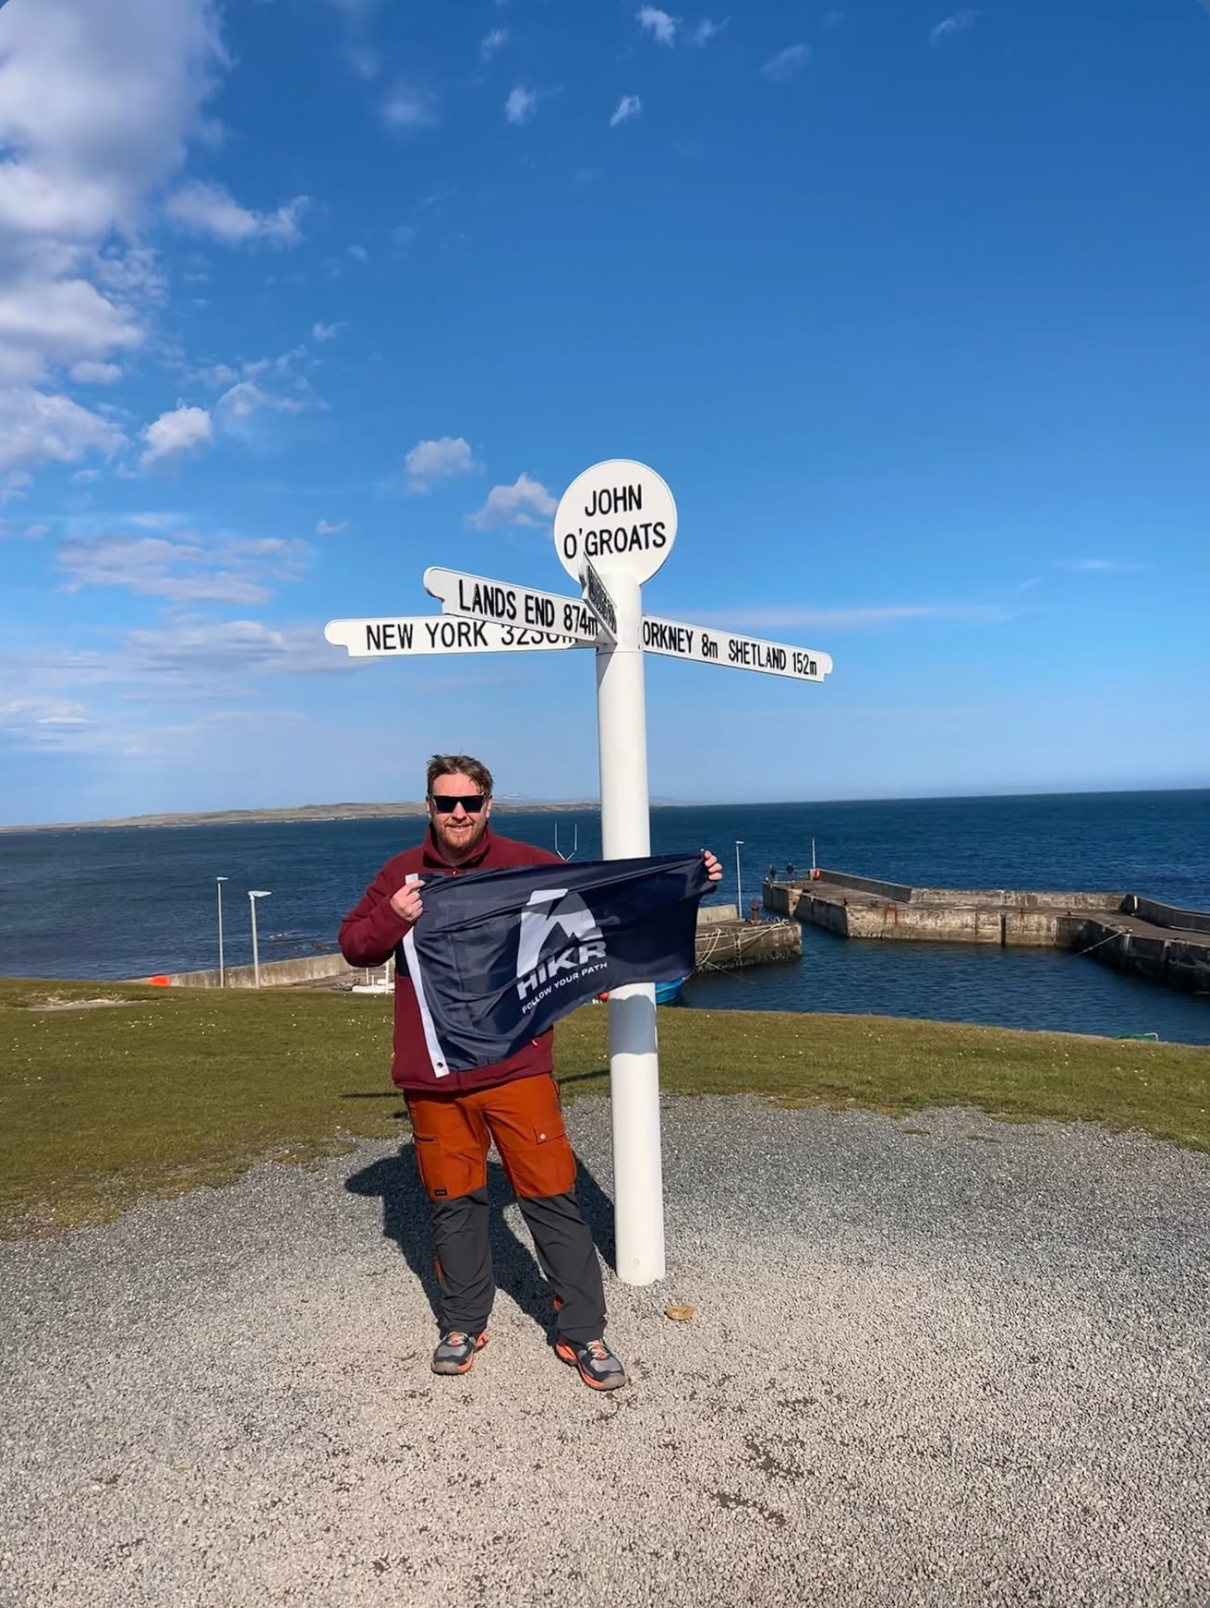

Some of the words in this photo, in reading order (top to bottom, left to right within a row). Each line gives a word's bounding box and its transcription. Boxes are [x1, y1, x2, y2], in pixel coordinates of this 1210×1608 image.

[585, 484, 642, 517] JOHN
[563, 521, 667, 559] O'GROATS
[459, 579, 517, 621] LANDS
[524, 594, 555, 628] END
[563, 604, 599, 636] 874m
[366, 624, 413, 651] NEW
[425, 621, 488, 648] YORK
[642, 620, 694, 654] ORKNEY
[701, 633, 719, 659] 8m
[728, 639, 787, 672] SHETLAND
[792, 652, 818, 676] 152m
[516, 941, 607, 1000] HIKR
[521, 985, 553, 1014] FOLLOW
[553, 971, 580, 989] YOUR
[581, 962, 608, 976] PATH
